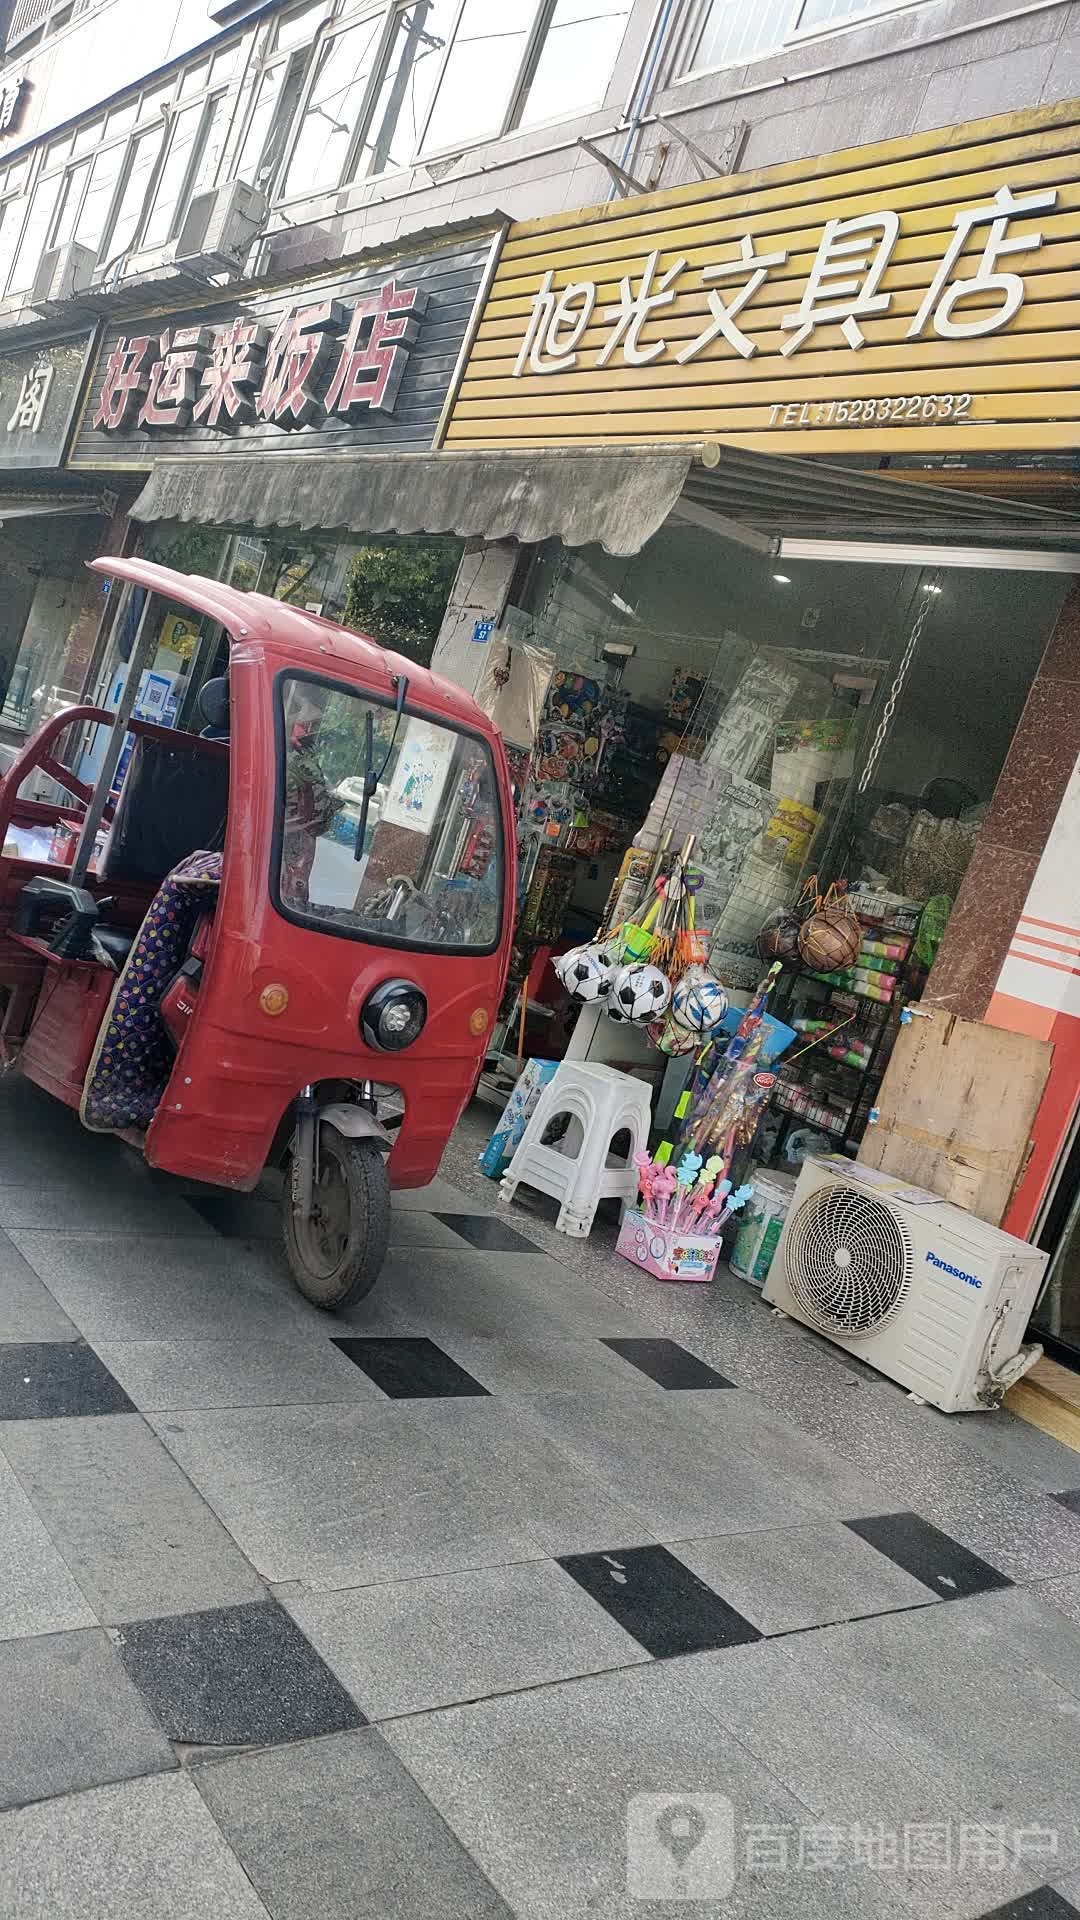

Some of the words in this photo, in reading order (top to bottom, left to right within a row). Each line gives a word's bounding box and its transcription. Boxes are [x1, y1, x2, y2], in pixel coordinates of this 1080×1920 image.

[512, 185, 1058, 378] 旭光文具店
[93, 278, 420, 430] 好运来饭店
[7, 363, 54, 433] 阁
[768, 393, 972, 425] TEL:1528322632
[925, 1251, 983, 1289] Panasonic
